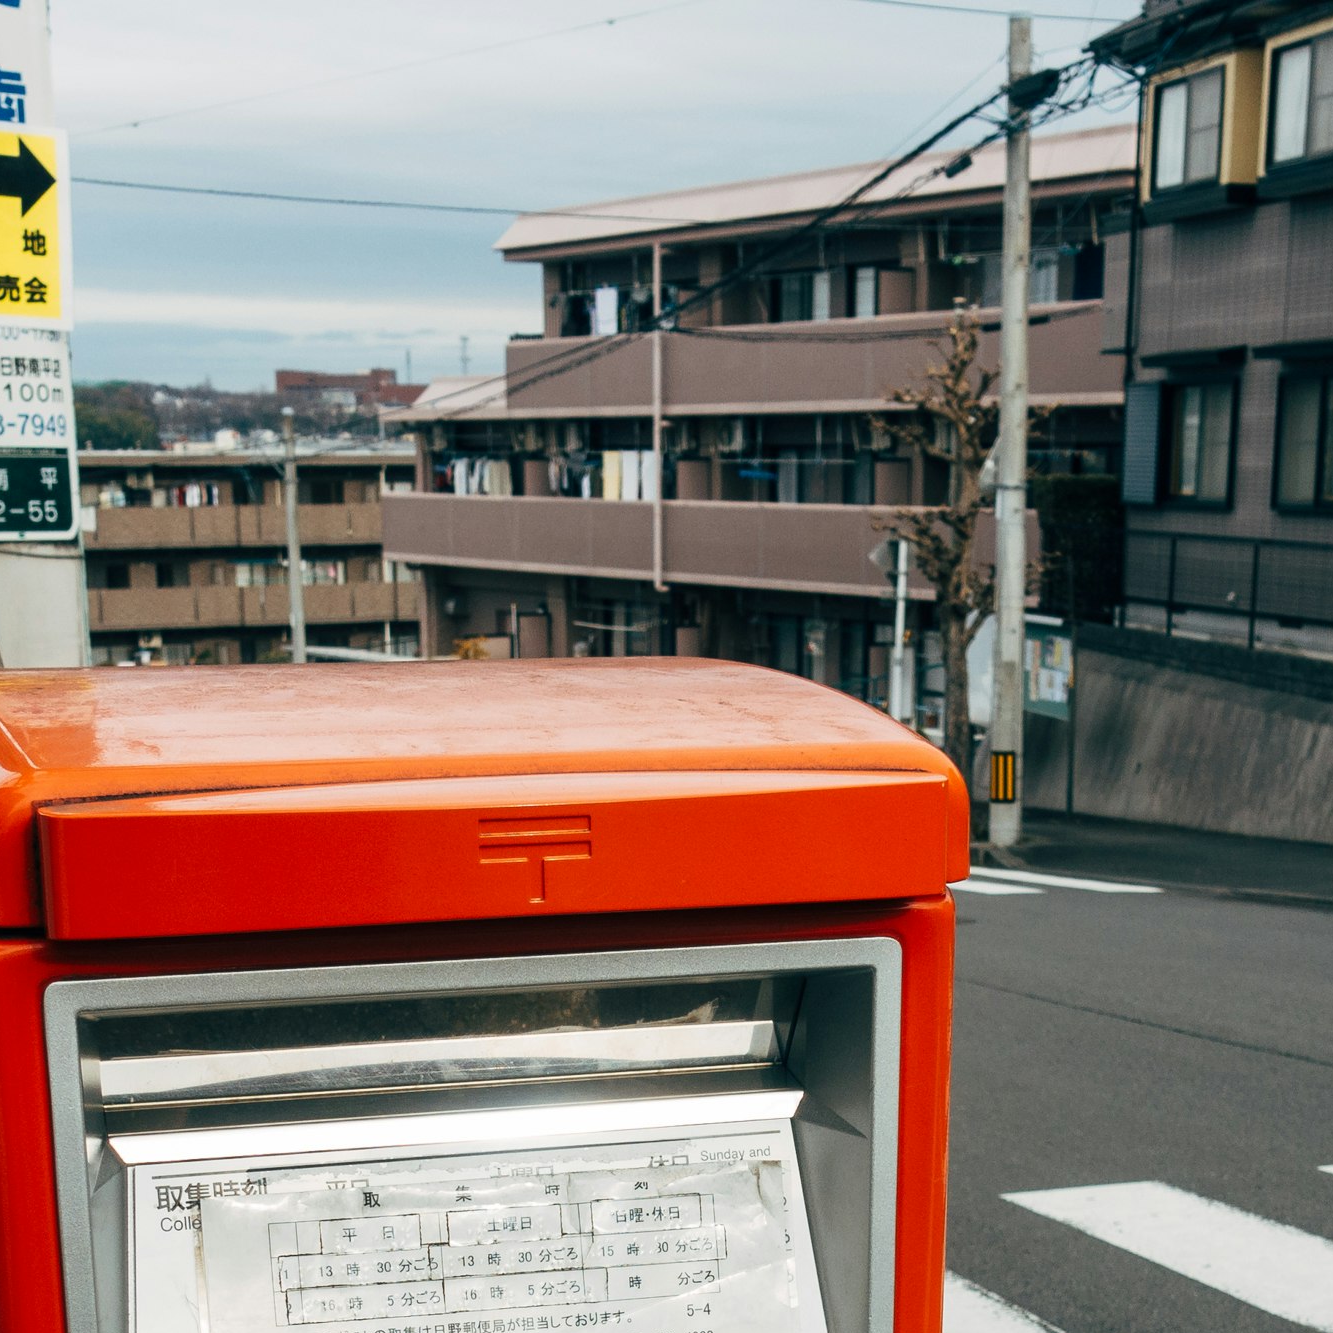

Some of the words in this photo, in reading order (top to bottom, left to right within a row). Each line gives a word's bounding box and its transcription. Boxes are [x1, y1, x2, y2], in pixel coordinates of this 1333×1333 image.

[700, 1148, 745, 1161] Sunday
[749, 1146, 771, 1158] and
[488, 1217, 532, 1232] 土曜日
[343, 1226, 395, 1242] 平日
[601, 1245, 614, 1257] 15
[627, 1242, 640, 1256] 時
[675, 1237, 713, 1253] 分ごろ
[461, 1256, 475, 1267] 13
[488, 1253, 502, 1266] 時
[518, 1251, 532, 1263] 30
[539, 1247, 579, 1263] 分ごろ
[319, 1267, 333, 1277] 13
[346, 1263, 361, 1276] 時
[377, 1262, 391, 1273] 30
[399, 1257, 439, 1273] 分ごろ
[629, 1276, 642, 1289] 時
[677, 1270, 716, 1286] 分ごろ
[528, 1285, 535, 1296] 5
[541, 1281, 581, 1297] 分ごろ
[387, 1296, 395, 1307] 5
[401, 1291, 441, 1307] 分ごろ
[686, 1303, 711, 1317] 5-4
